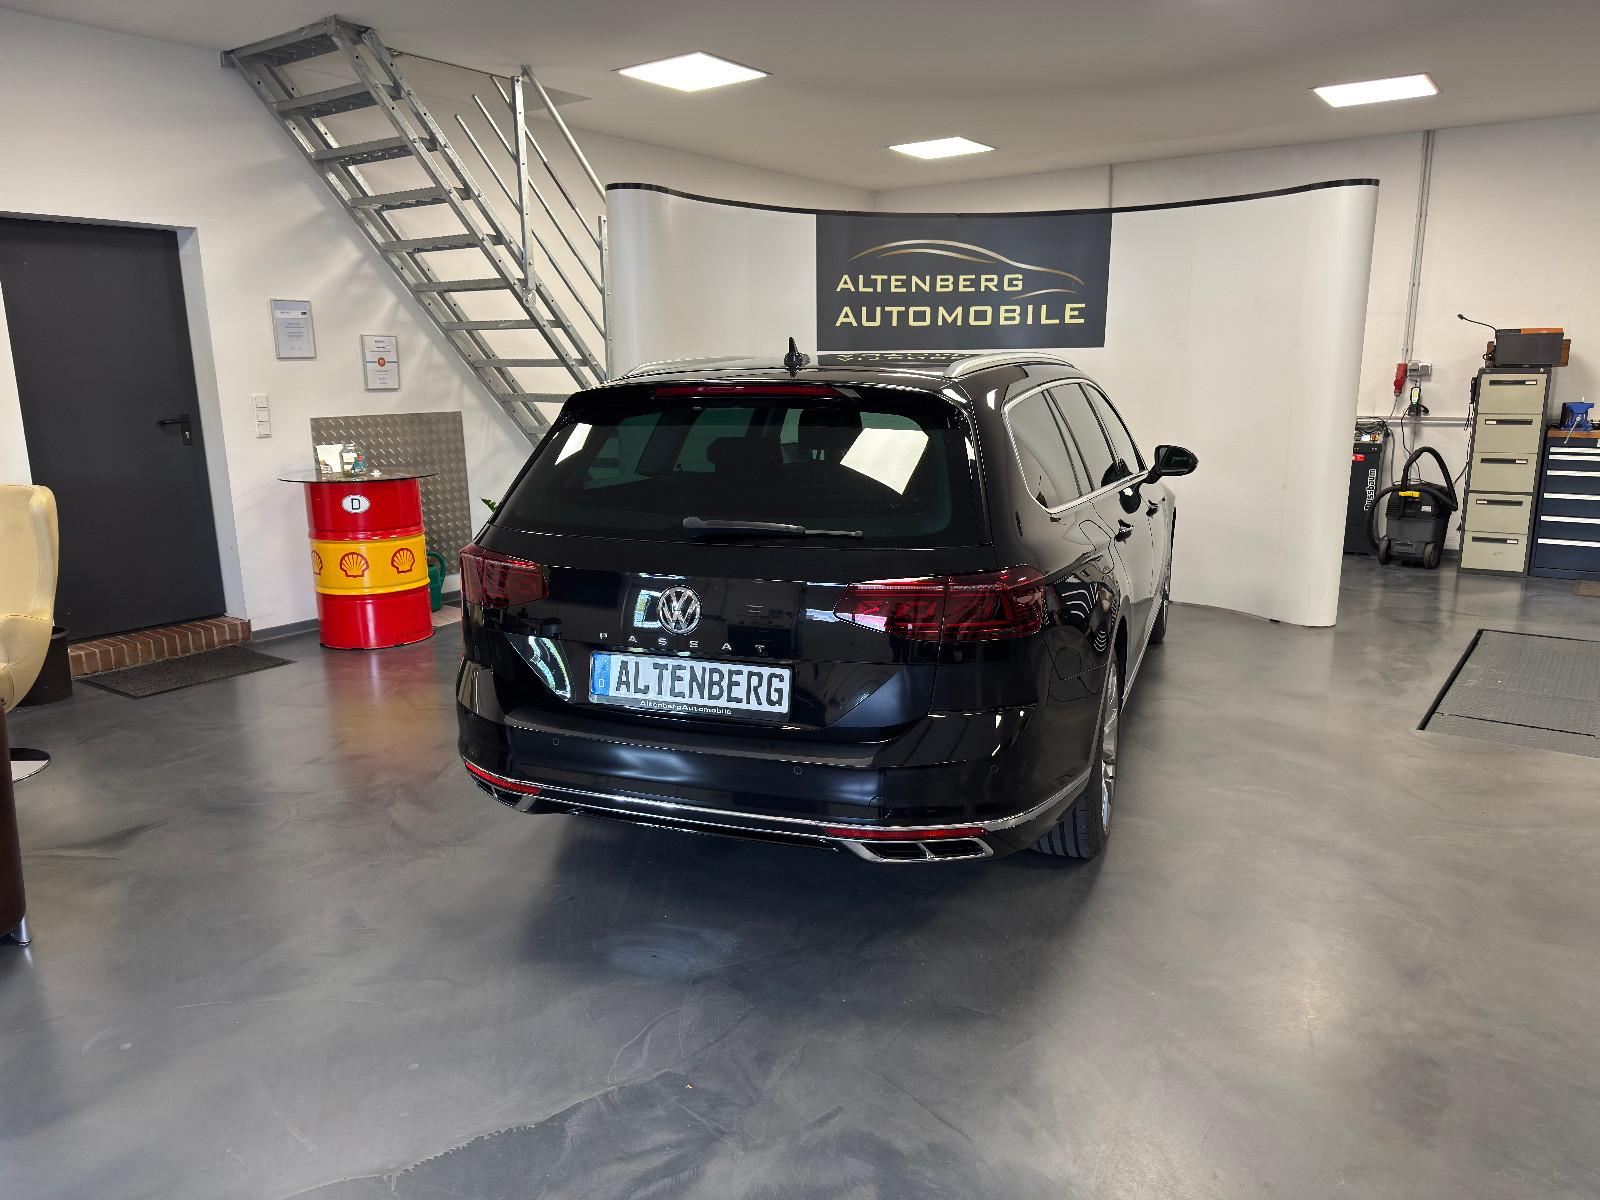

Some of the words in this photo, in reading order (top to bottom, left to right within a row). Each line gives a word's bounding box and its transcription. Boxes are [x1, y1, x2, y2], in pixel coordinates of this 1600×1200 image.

[835, 273, 1024, 293] ALTENBERG
[835, 303, 1086, 327] AUTOMOBILE
[351, 498, 361, 510] D
[599, 631, 766, 653] PASSAT
[598, 678, 605, 688] D
[614, 660, 785, 707] ALTENBERG
[640, 700, 732, 715] AltenbergAutomobile
